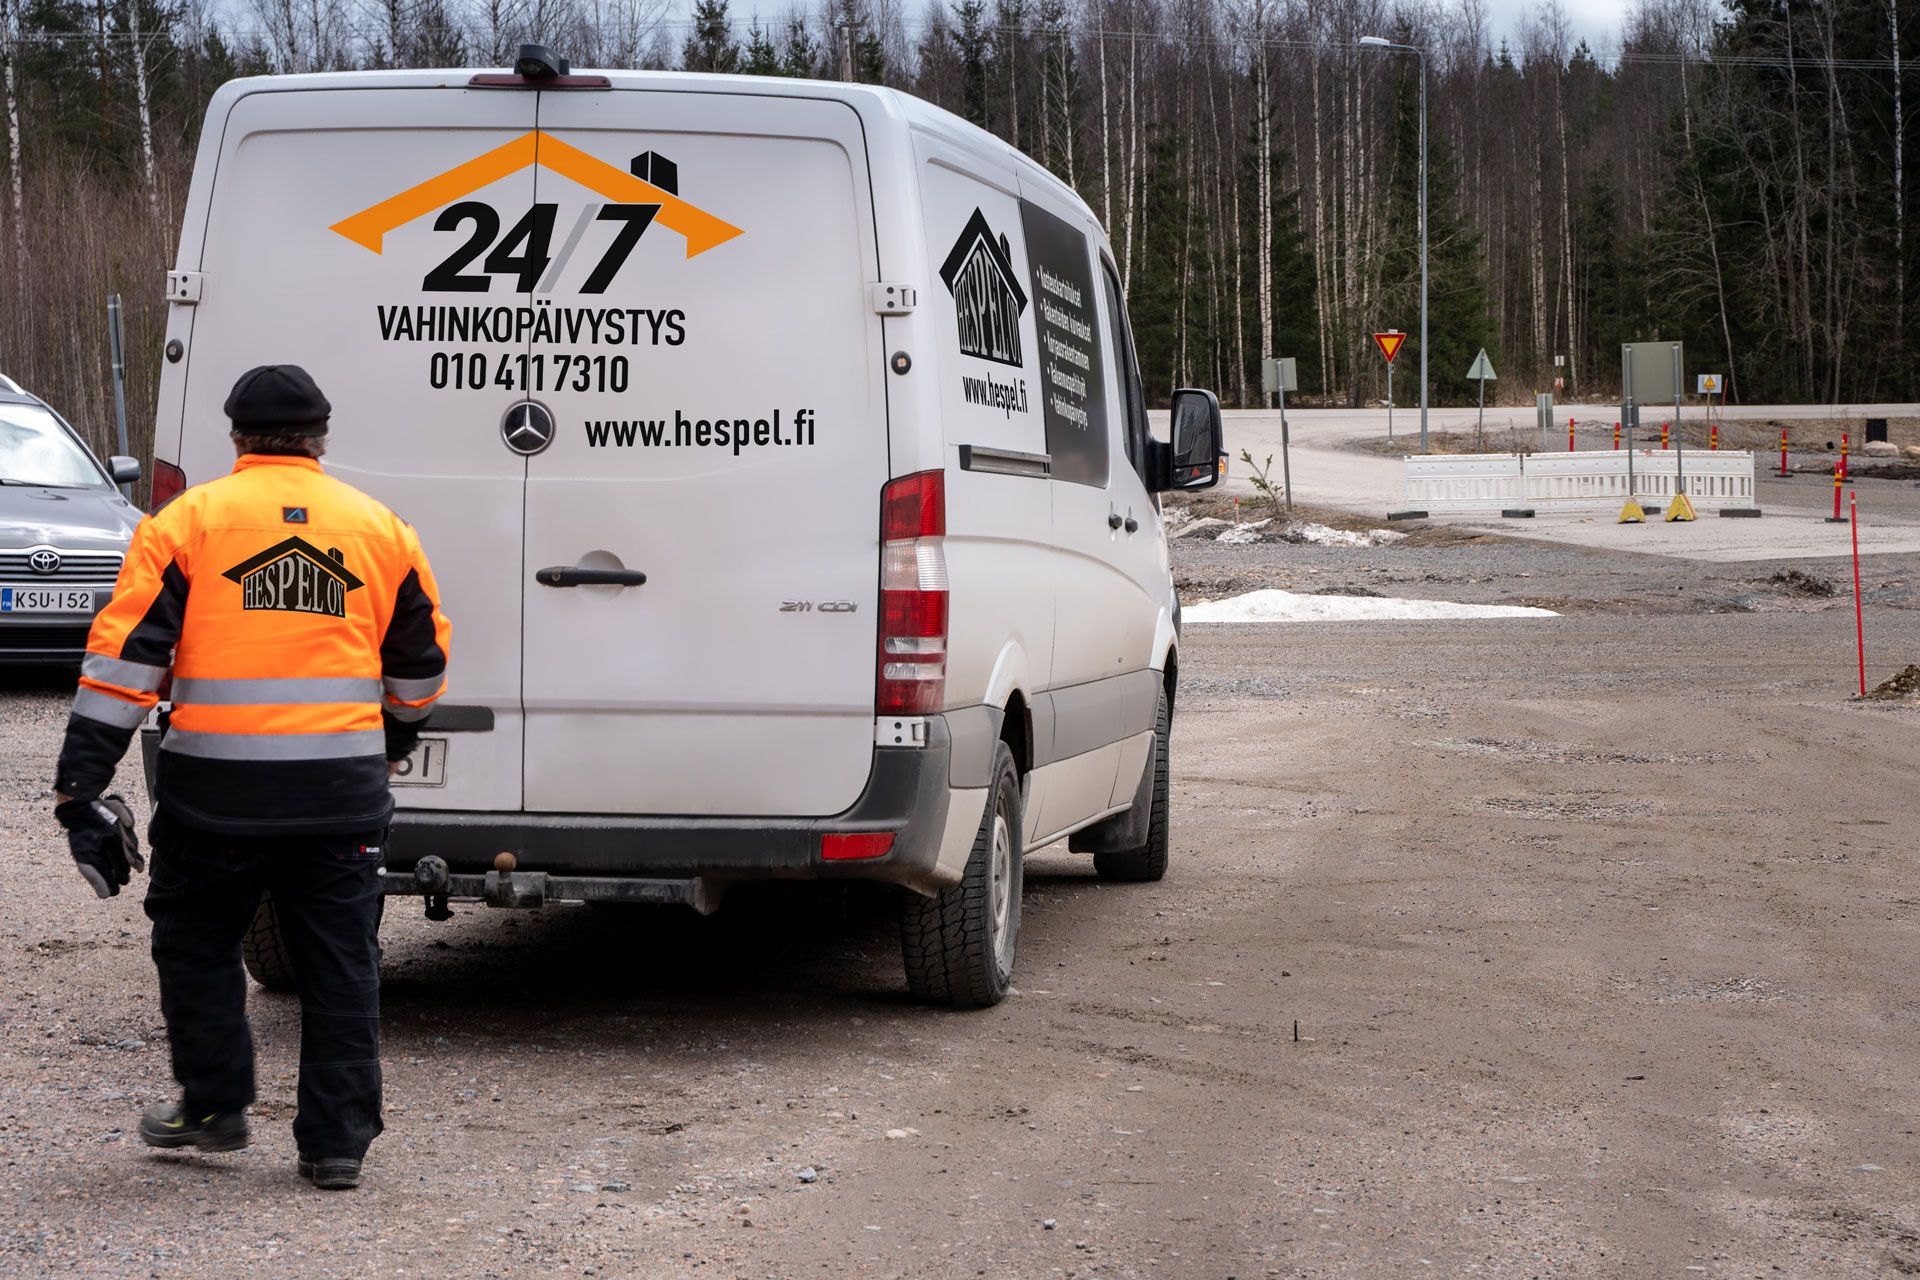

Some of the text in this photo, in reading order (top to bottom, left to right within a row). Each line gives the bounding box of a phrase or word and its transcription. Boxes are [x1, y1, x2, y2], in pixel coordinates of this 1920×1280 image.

[421, 201, 662, 294] 24/7
[377, 300, 686, 346] VAHINKOPÄIVYSTYS
[955, 246, 1009, 361] HESPEL
[430, 352, 629, 393] 010 411 7310
[963, 372, 1028, 419] www.hespel.fi
[585, 409, 815, 456] www.hespel.fi
[15, 592, 89, 609] KSU-152
[245, 555, 343, 616] HESPEL OY
